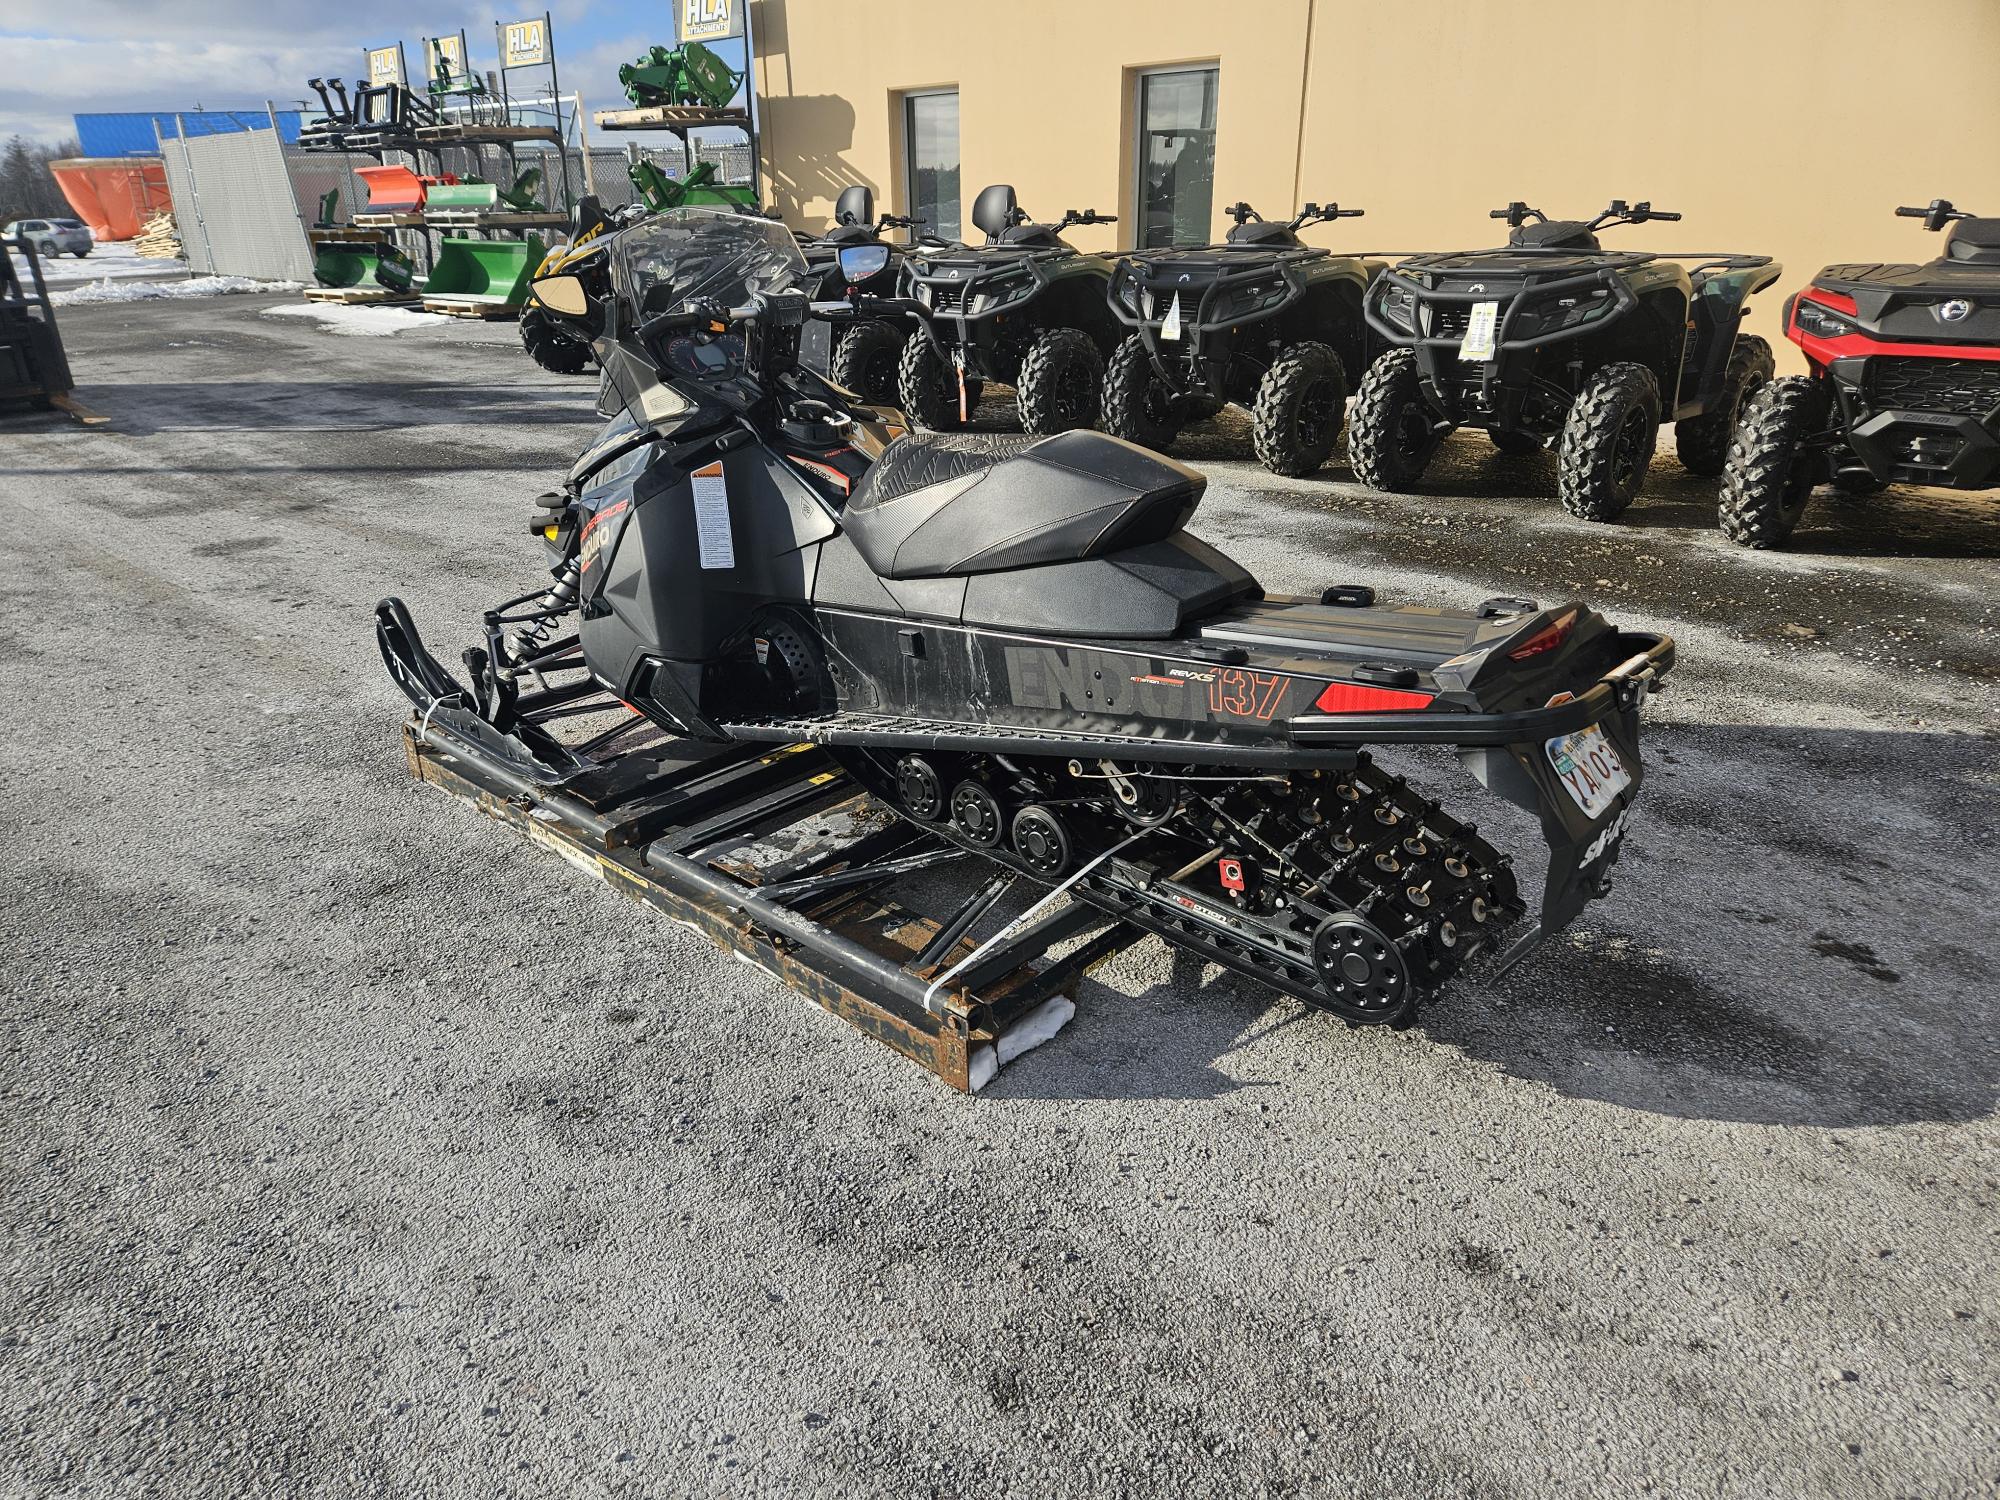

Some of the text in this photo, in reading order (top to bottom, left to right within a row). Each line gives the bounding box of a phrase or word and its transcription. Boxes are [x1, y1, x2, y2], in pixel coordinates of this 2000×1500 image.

[686, 0, 728, 26] HLA
[509, 25, 542, 52] HLA
[688, 23, 728, 35] ATTACHMENTS
[372, 51, 397, 74] HLA
[803, 462, 832, 481] ENDURO
[1209, 666, 1291, 721] 137
